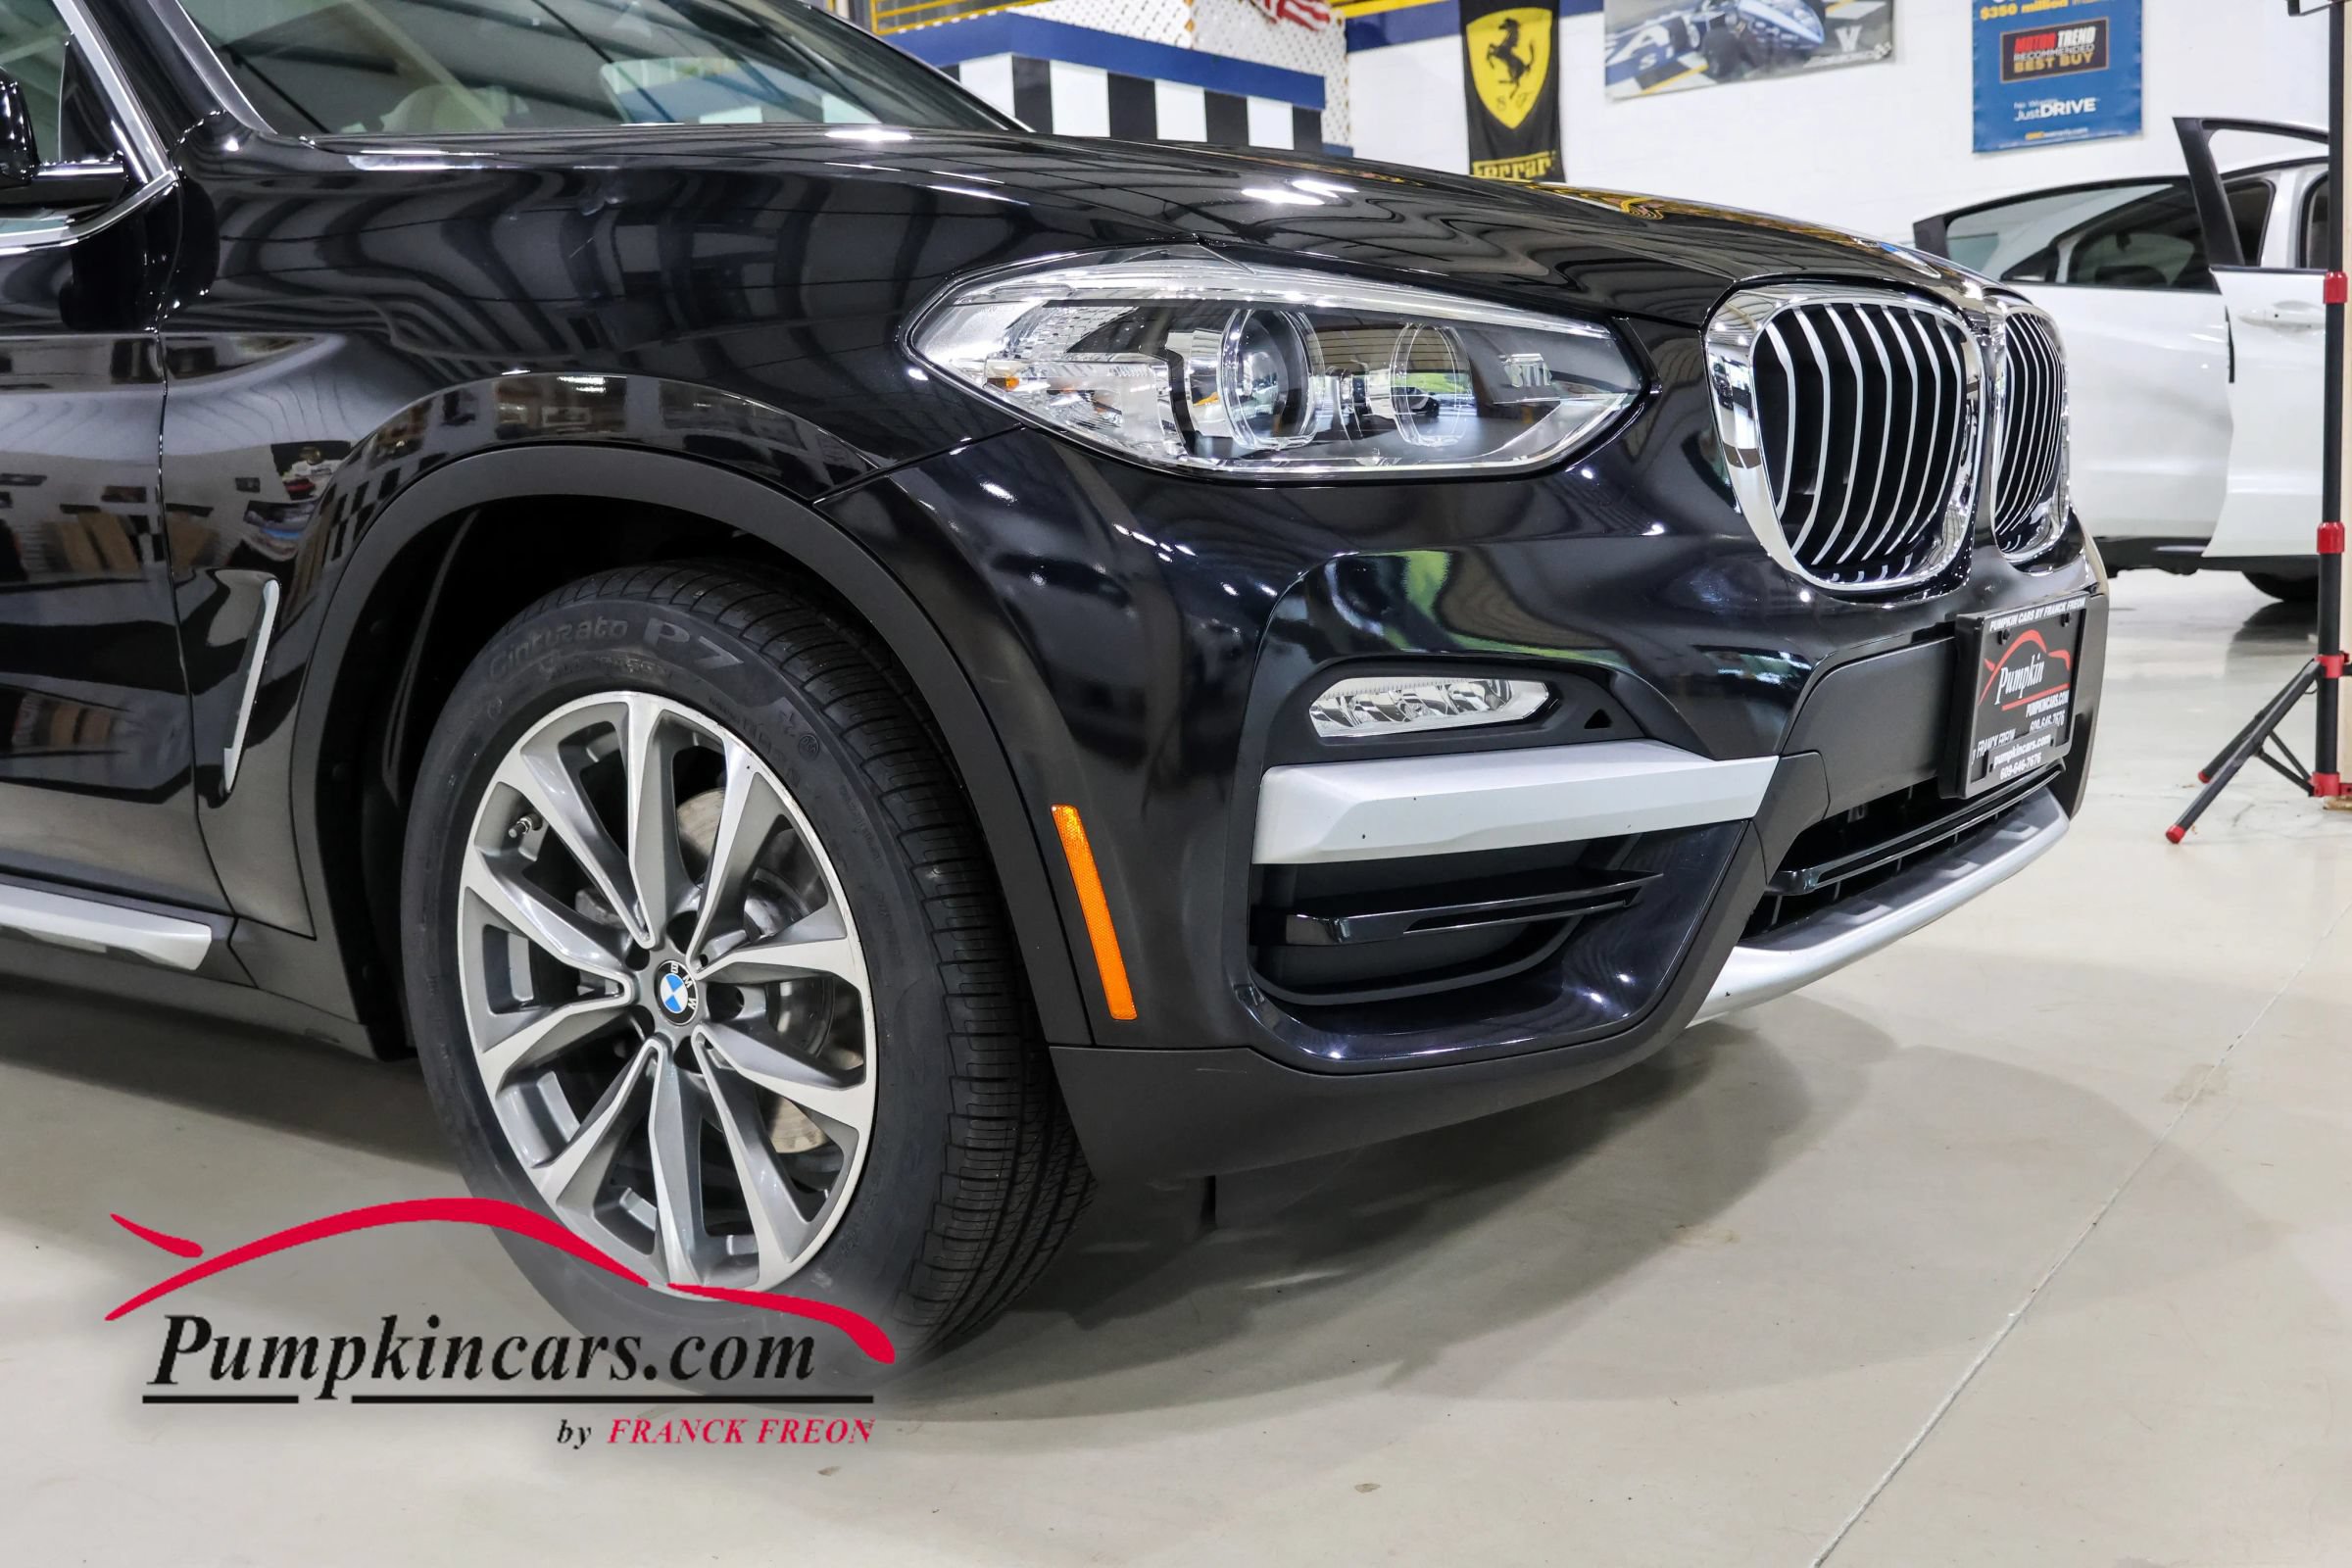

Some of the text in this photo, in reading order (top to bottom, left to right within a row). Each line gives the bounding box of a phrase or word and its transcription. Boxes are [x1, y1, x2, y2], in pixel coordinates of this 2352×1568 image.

[2058, 26, 2097, 48] TREND
[2014, 53, 2094, 74] BEST BUY
[1989, 613, 2019, 632] PUMPKIN
[2019, 610, 2035, 624] CARS
[2034, 608, 2045, 619] BY
[2044, 602, 2067, 616] FRANCK
[1994, 653, 2045, 705] Pumpkin
[1993, 734, 2051, 768] pumpkincars.com
